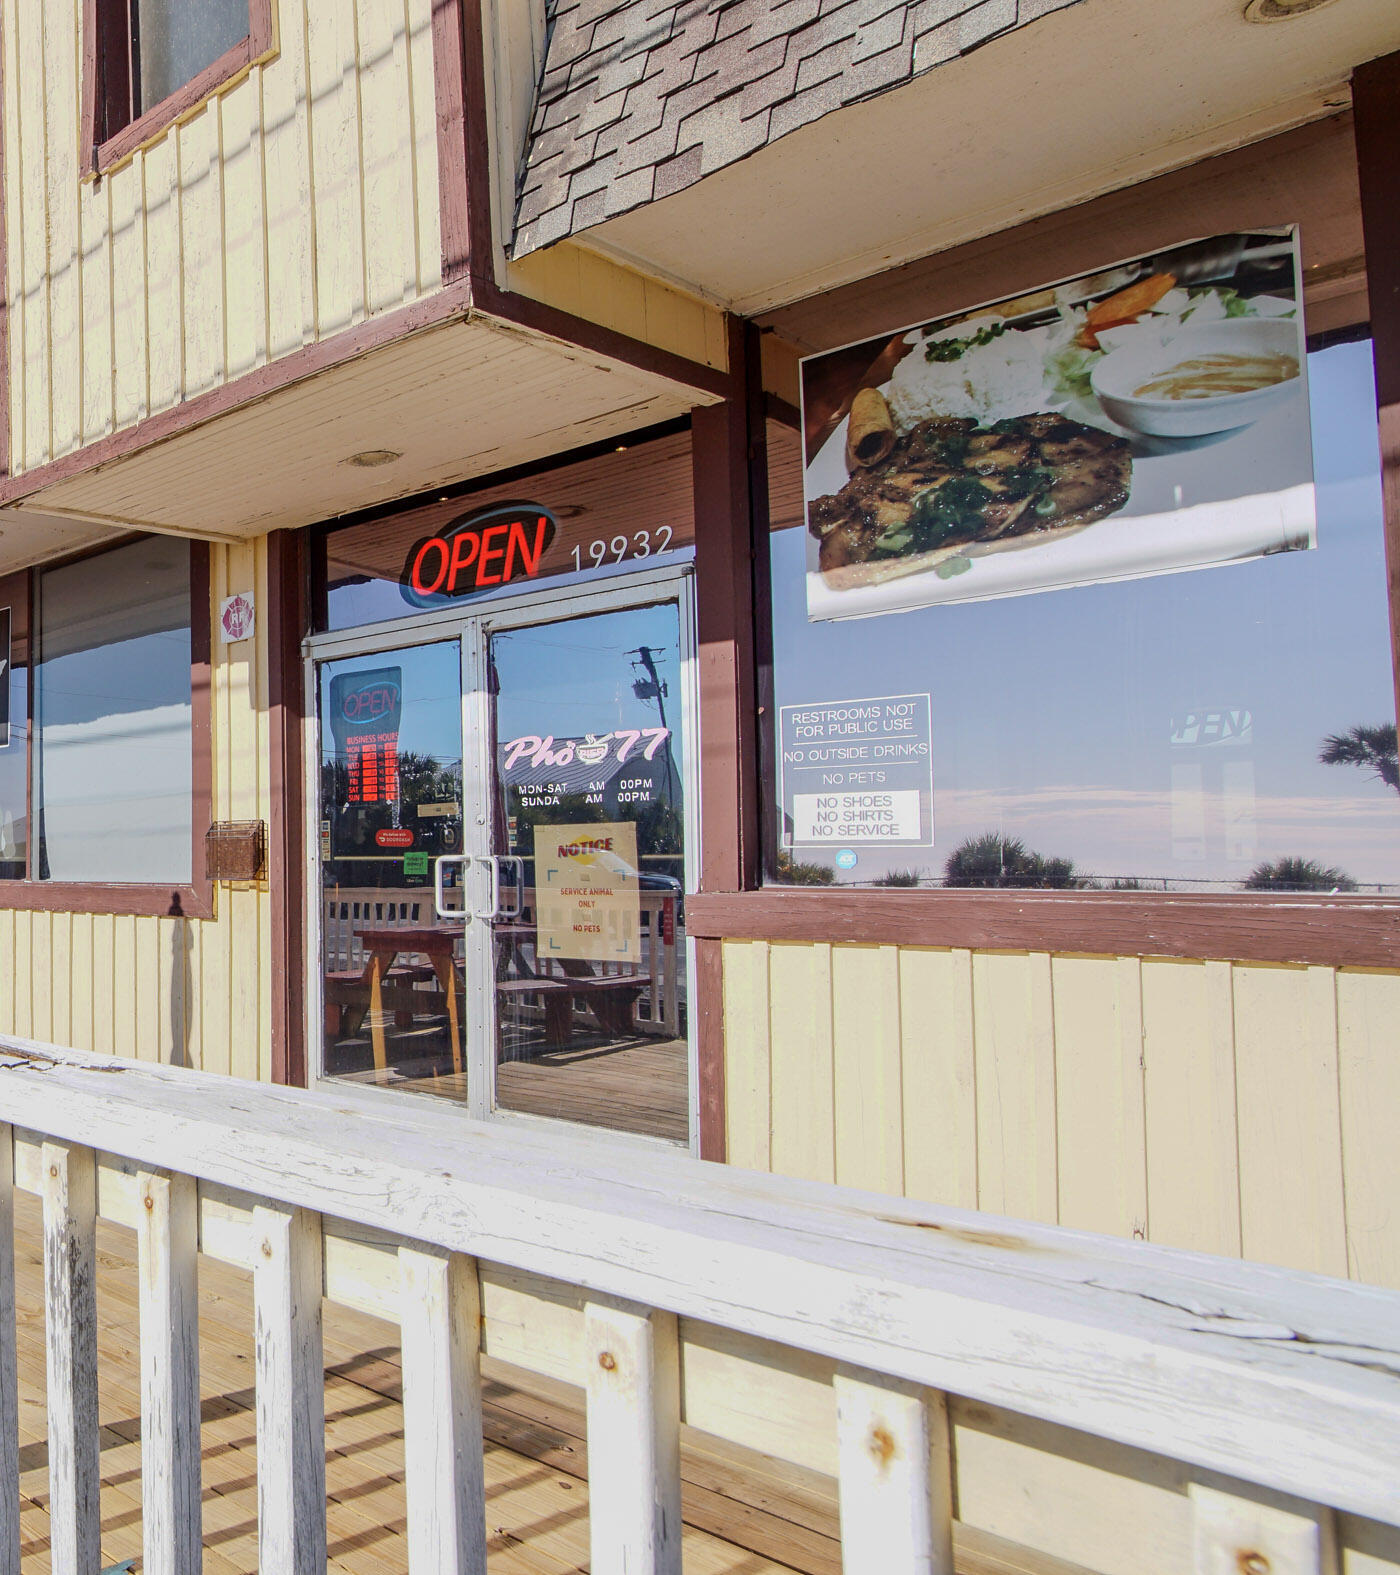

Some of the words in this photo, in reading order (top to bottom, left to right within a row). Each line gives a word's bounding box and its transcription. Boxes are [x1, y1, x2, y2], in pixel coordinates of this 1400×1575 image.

[411, 516, 547, 597] OPEN
[570, 525, 674, 572] 19932
[343, 688, 397, 717] OPEN
[791, 706, 881, 725] RESTROOMS
[886, 702, 917, 717] NOT
[795, 725, 825, 738] FOR
[828, 720, 879, 736] PUBLIC
[882, 717, 913, 732] USE
[346, 734, 376, 745] BUSINESS
[614, 727, 669, 763] 77
[783, 750, 804, 764] NO
[808, 746, 869, 762] OUTSIDE
[874, 742, 929, 758] DRINKS
[822, 773, 844, 785] NO
[848, 771, 887, 784] PETS
[518, 783, 568, 795] MON-SAT
[589, 781, 605, 791] AM
[620, 778, 653, 790] 00PM
[348, 794, 360, 802] SUN
[521, 796, 560, 807] SUNDA
[585, 793, 603, 804] AM
[617, 791, 650, 803] 00PM
[816, 797, 838, 809] NO
[842, 795, 893, 808] SHOES
[817, 811, 839, 822] NO
[842, 809, 894, 822] SHIRTS
[811, 824, 833, 837] NO
[837, 823, 900, 837] SERVICE
[557, 837, 614, 859] NOTICE
[560, 888, 588, 896] SERVICE
[589, 888, 614, 896] ANIMAL
[578, 900, 595, 908] ONLY
[573, 924, 583, 932] NO
[584, 925, 601, 933] PETS
